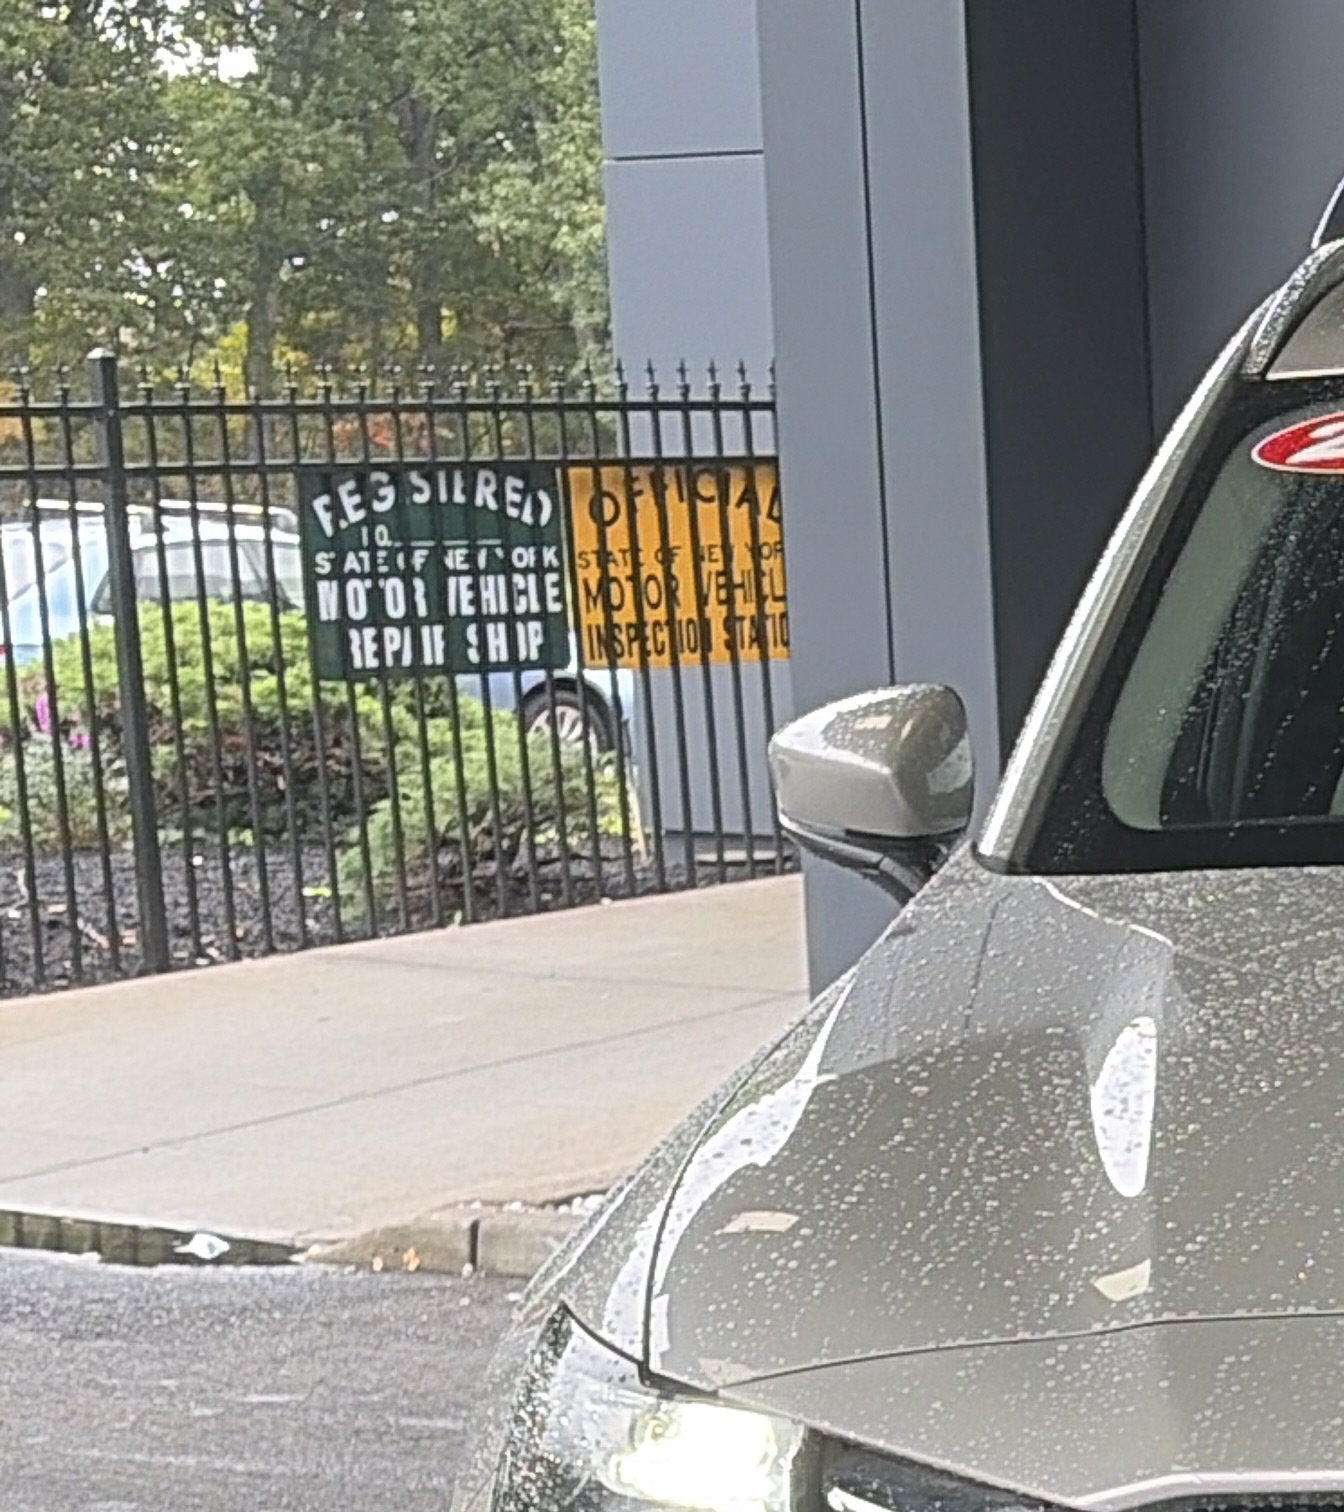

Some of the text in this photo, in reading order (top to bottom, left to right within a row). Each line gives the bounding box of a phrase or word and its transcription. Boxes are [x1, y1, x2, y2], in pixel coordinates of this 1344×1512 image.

[312, 469, 553, 538] REGSTERED
[588, 470, 782, 528] OFICIAL
[314, 550, 390, 575] SATE
[494, 545, 561, 569] ORK
[577, 547, 645, 570] STAT
[586, 617, 712, 661] INSPCIO
